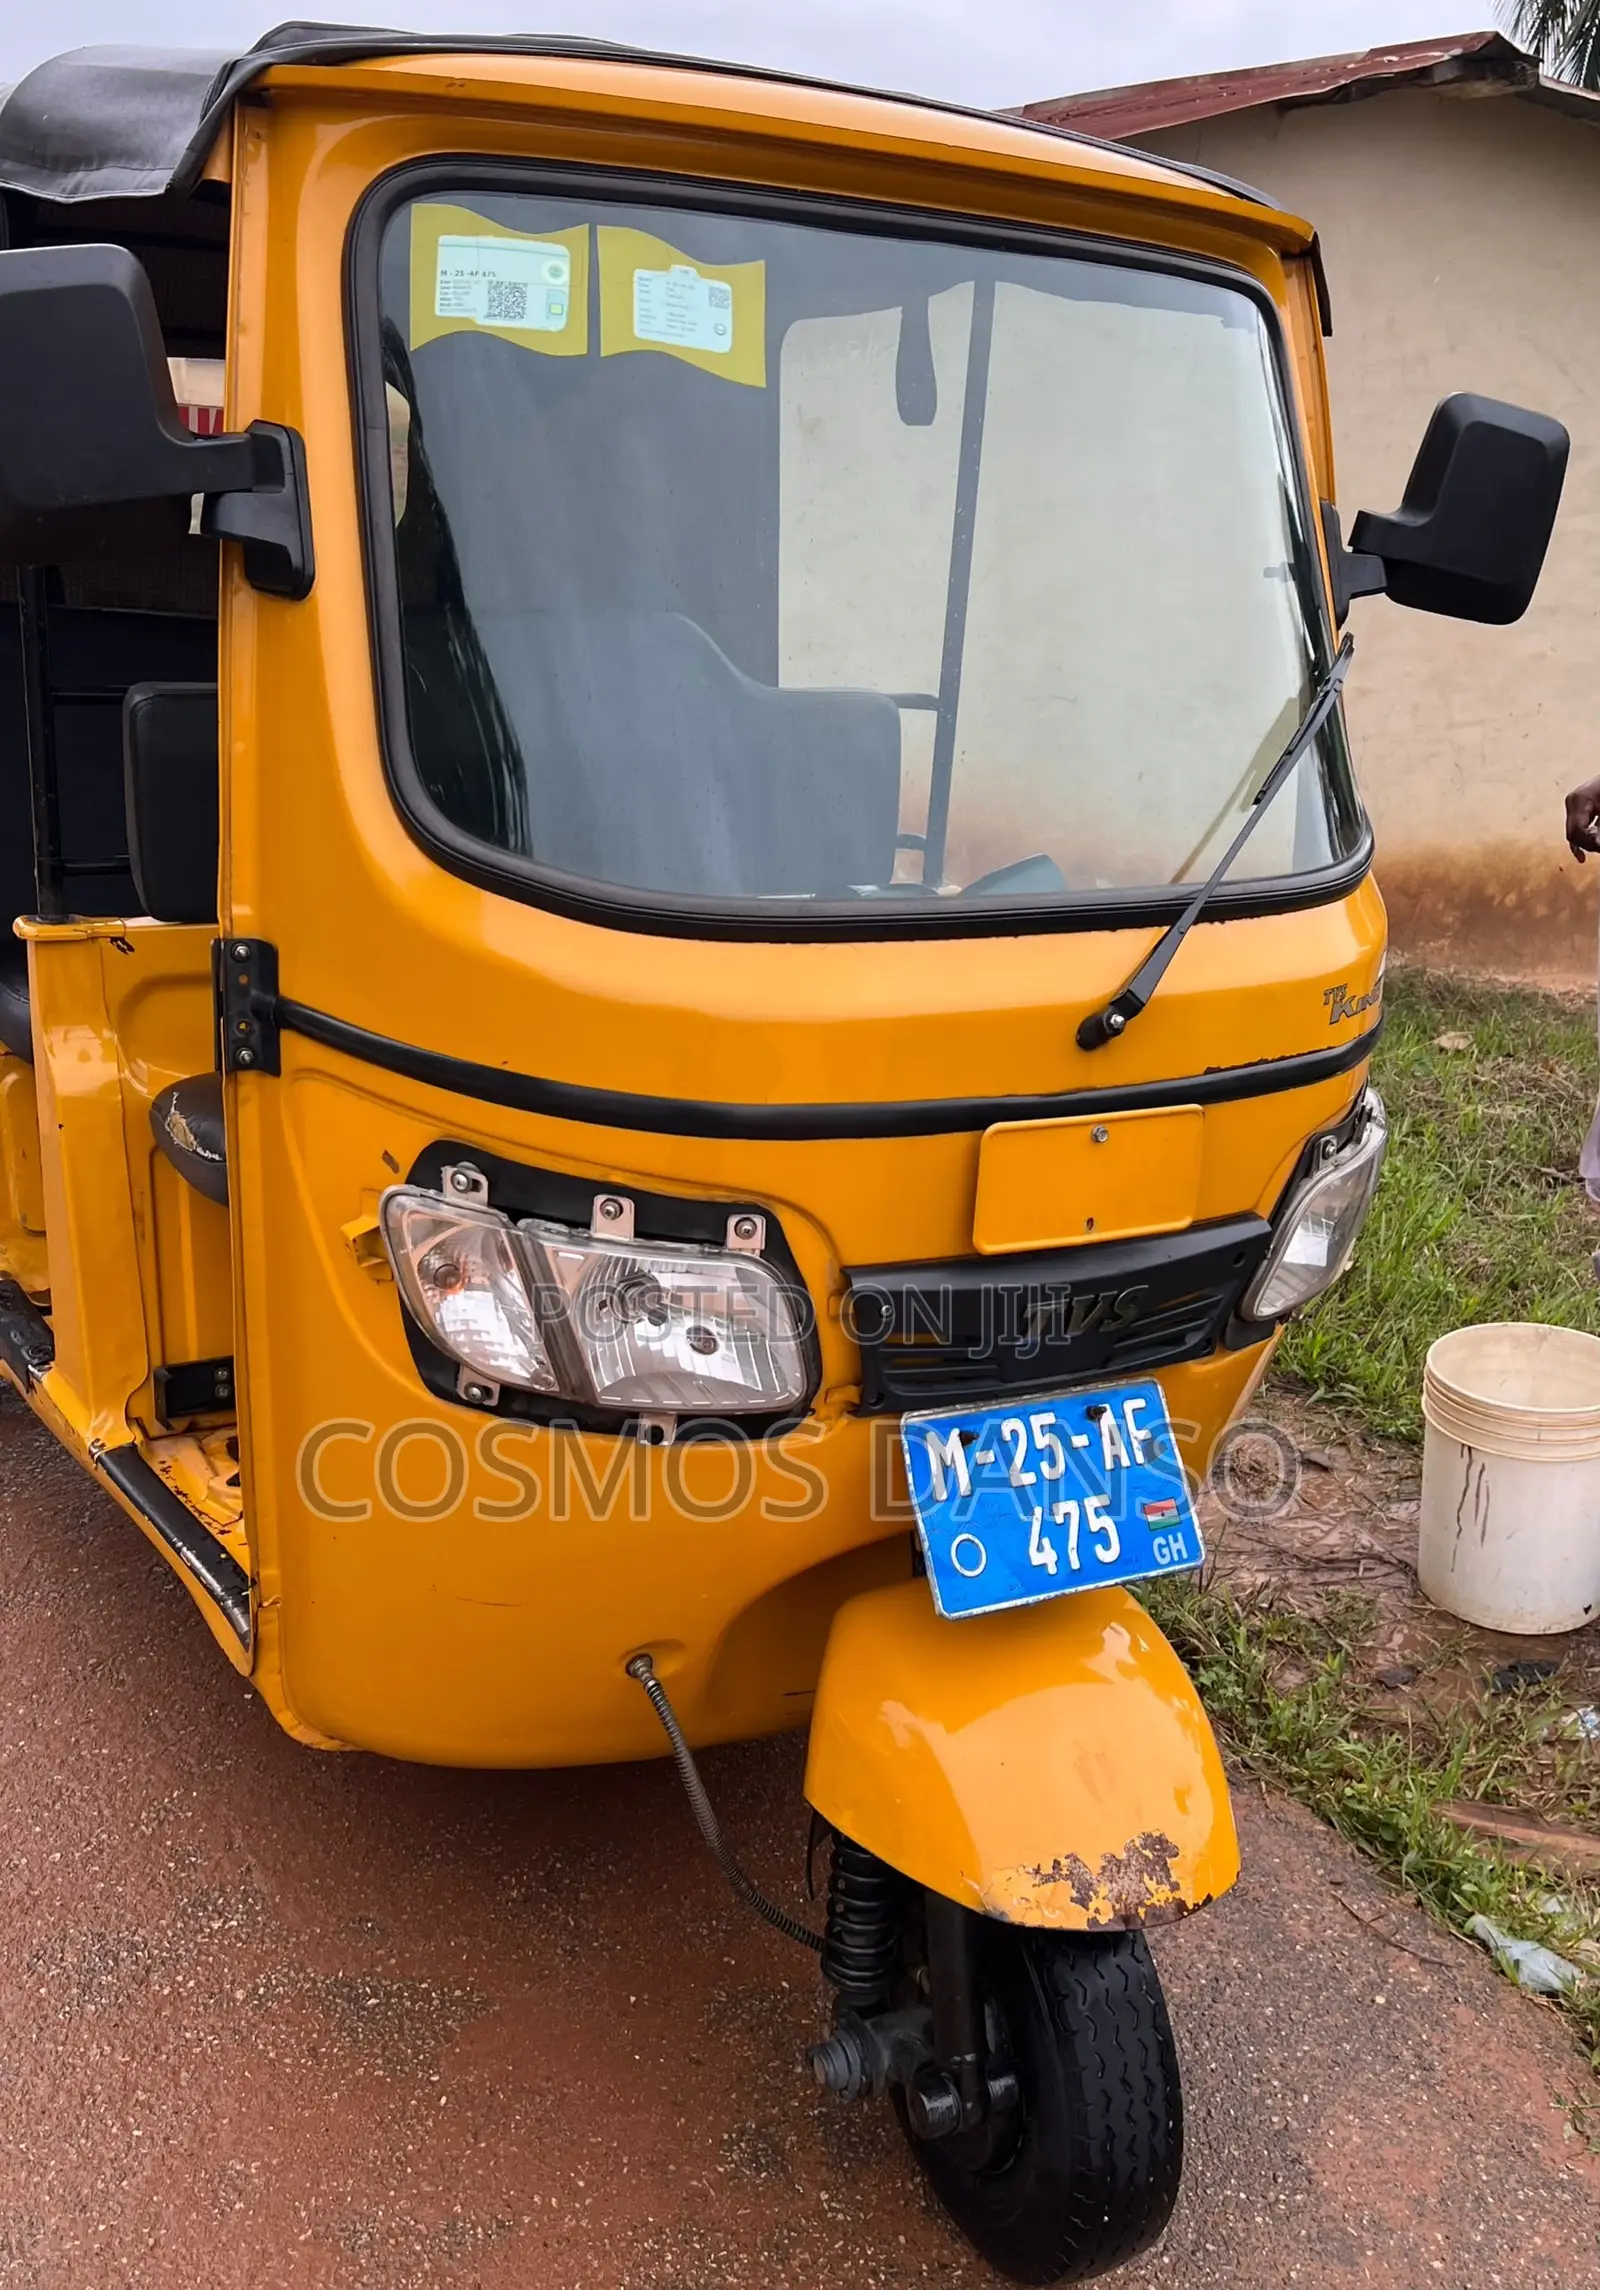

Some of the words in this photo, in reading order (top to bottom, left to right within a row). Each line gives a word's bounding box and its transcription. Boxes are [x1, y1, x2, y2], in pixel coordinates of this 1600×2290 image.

[1323, 983, 1348, 1006] TVS
[1017, 1285, 1149, 1344] TVS
[925, 1398, 1151, 1502] M-25-AF
[1028, 1494, 1121, 1576] 475
[1152, 1531, 1189, 1566] GH
